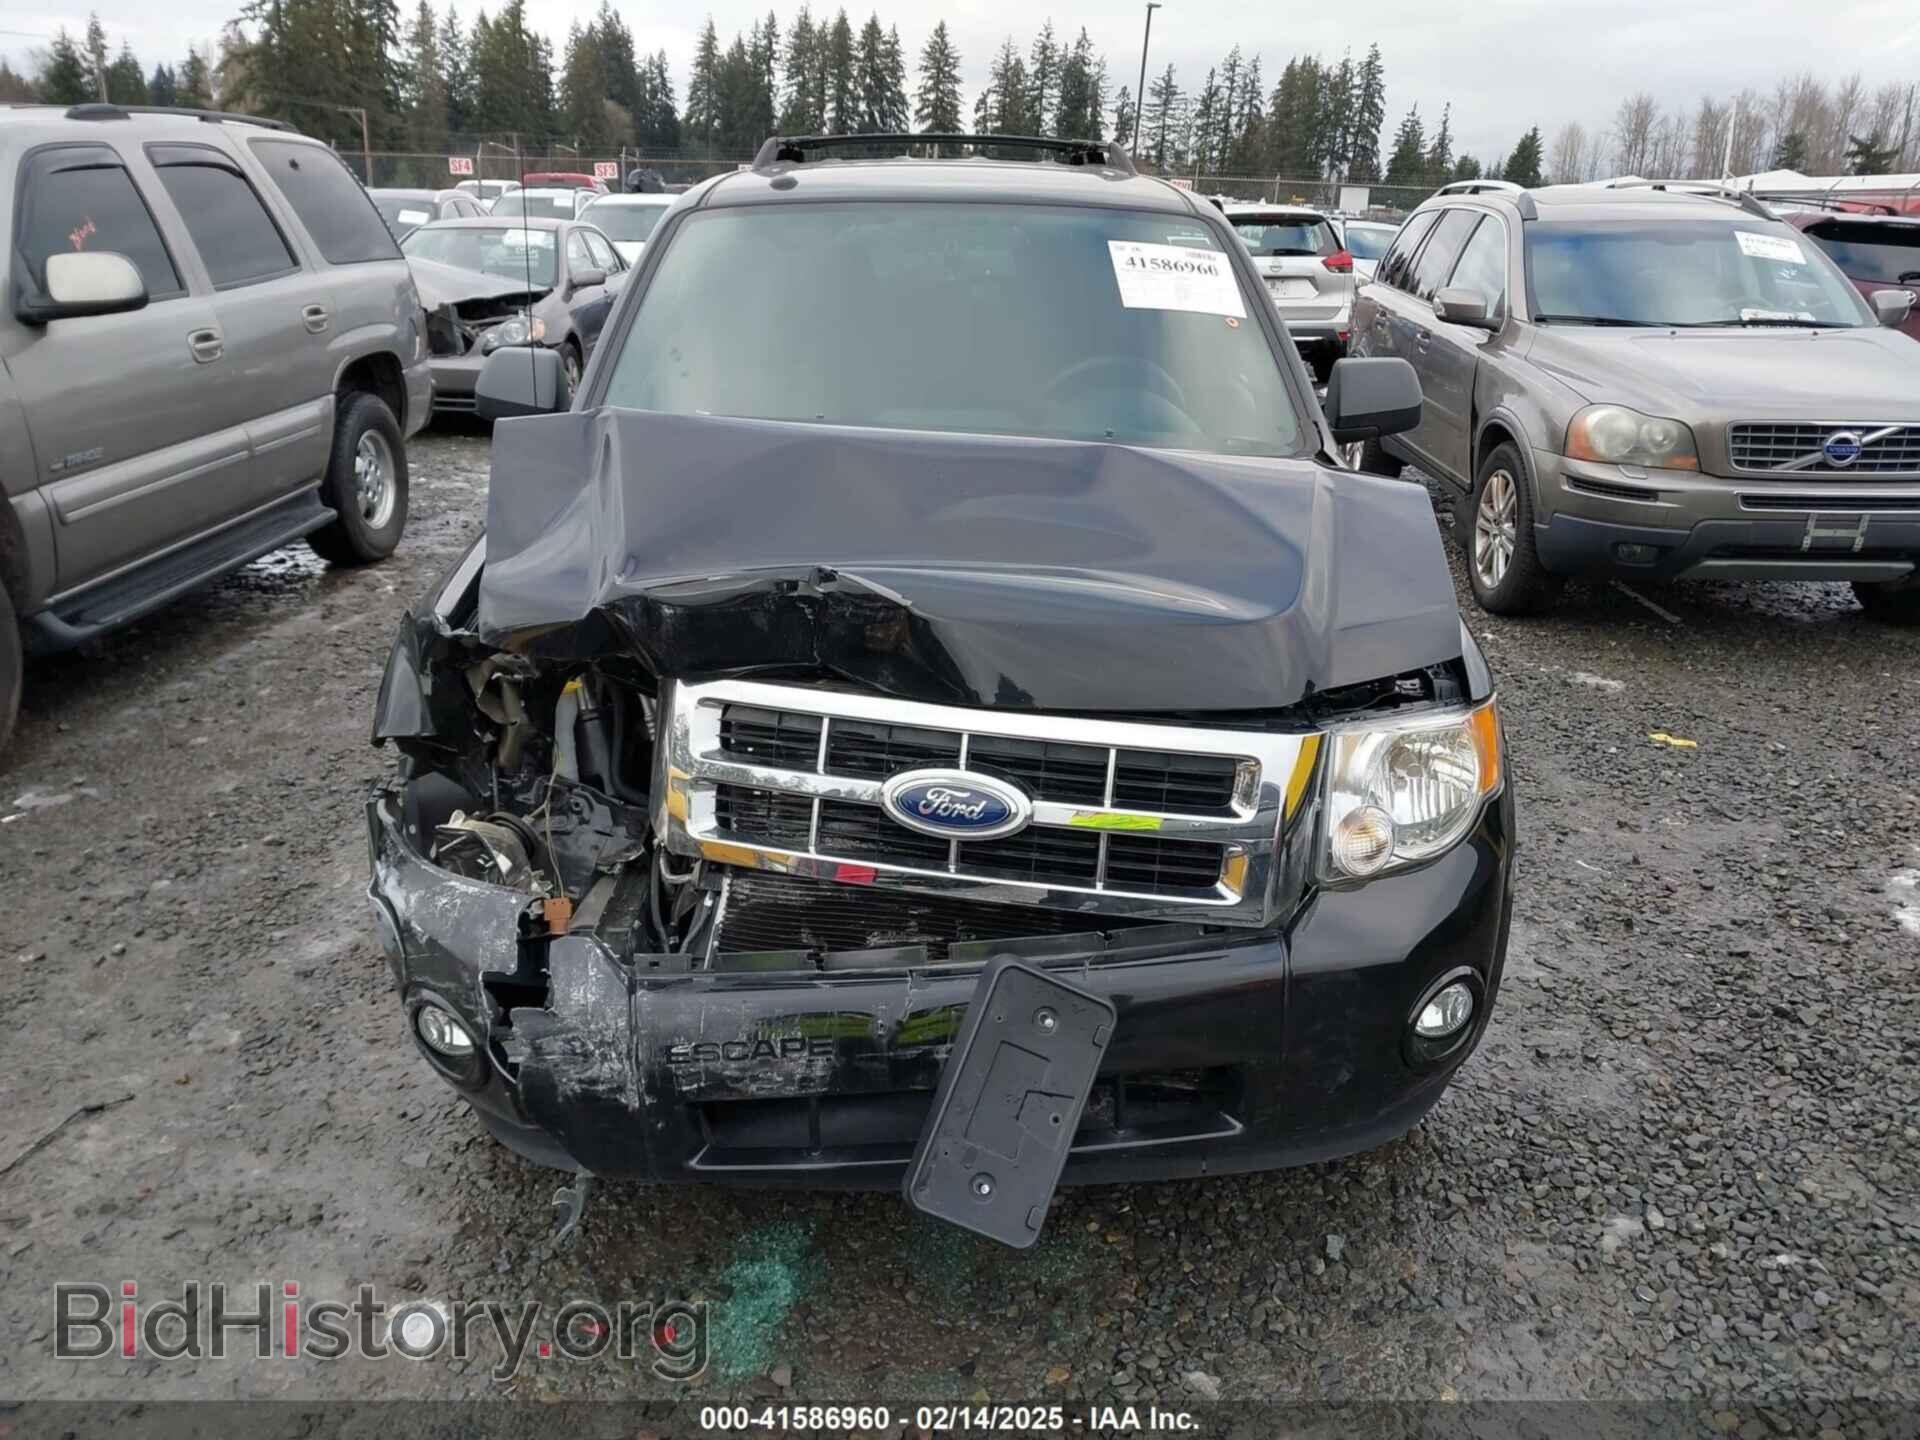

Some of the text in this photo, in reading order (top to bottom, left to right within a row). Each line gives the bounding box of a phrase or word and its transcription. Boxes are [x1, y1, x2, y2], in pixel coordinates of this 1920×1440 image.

[452, 158, 472, 172] SF4
[597, 163, 616, 176] SF3
[918, 787, 988, 820] Ford
[665, 1036, 833, 1064] ESCAPE
